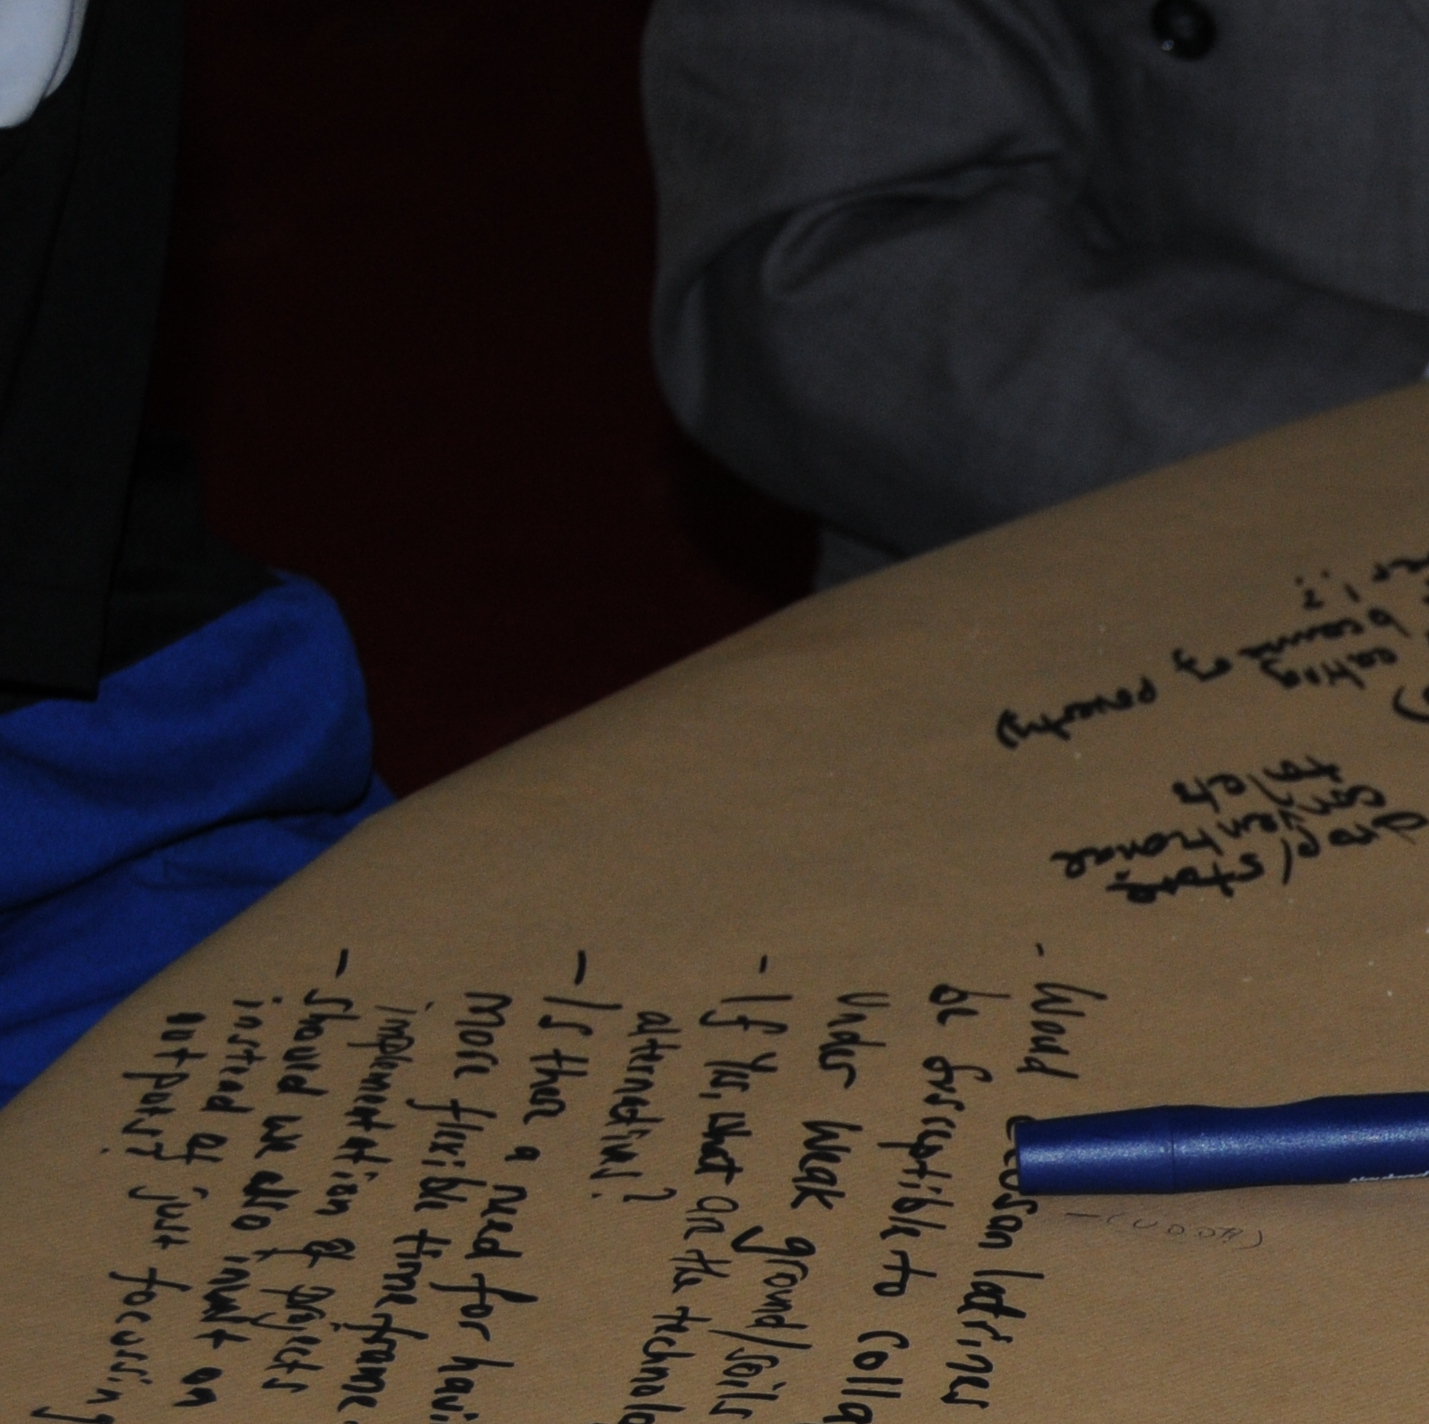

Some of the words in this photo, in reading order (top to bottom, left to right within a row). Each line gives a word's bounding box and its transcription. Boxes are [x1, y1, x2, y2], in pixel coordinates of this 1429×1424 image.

[929, 983, 1012, 1026] be
[406, 1099, 498, 1212] flexible
[872, 1250, 938, 1297] to
[429, 1273, 541, 1343] for
